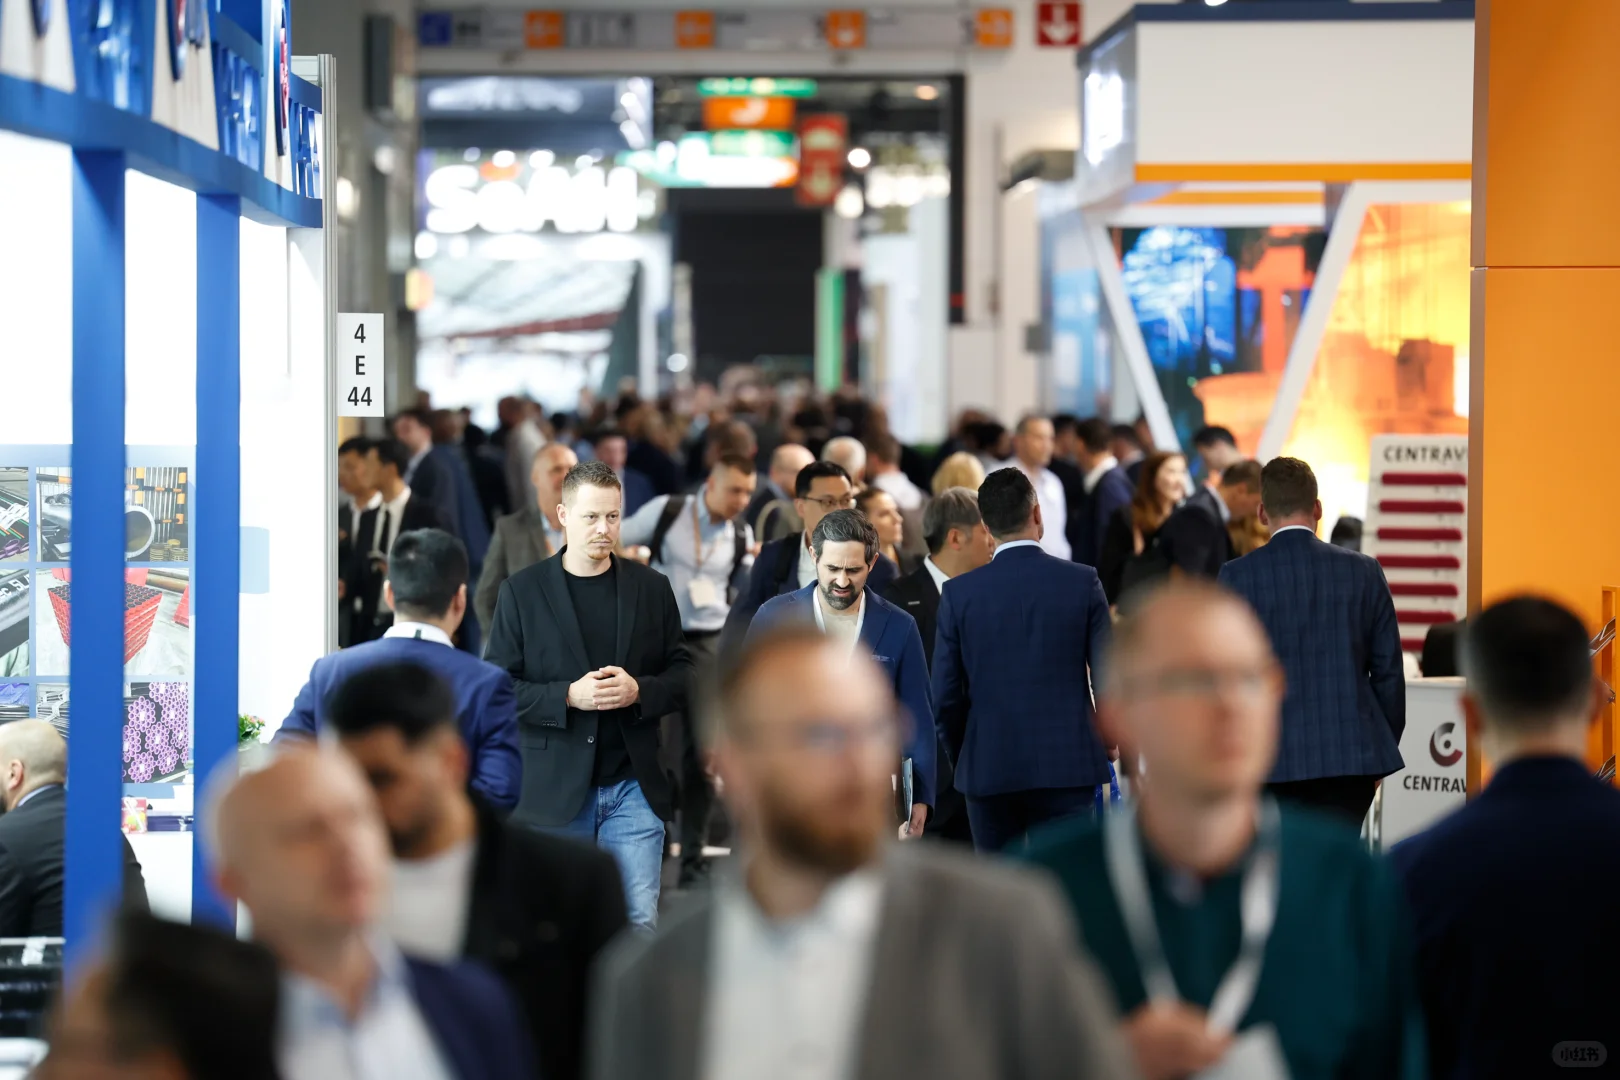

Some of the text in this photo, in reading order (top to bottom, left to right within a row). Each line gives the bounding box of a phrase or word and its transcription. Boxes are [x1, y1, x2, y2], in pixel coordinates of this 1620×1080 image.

[354, 323, 366, 343] 4
[355, 355, 366, 375] E
[347, 386, 372, 406] 44
